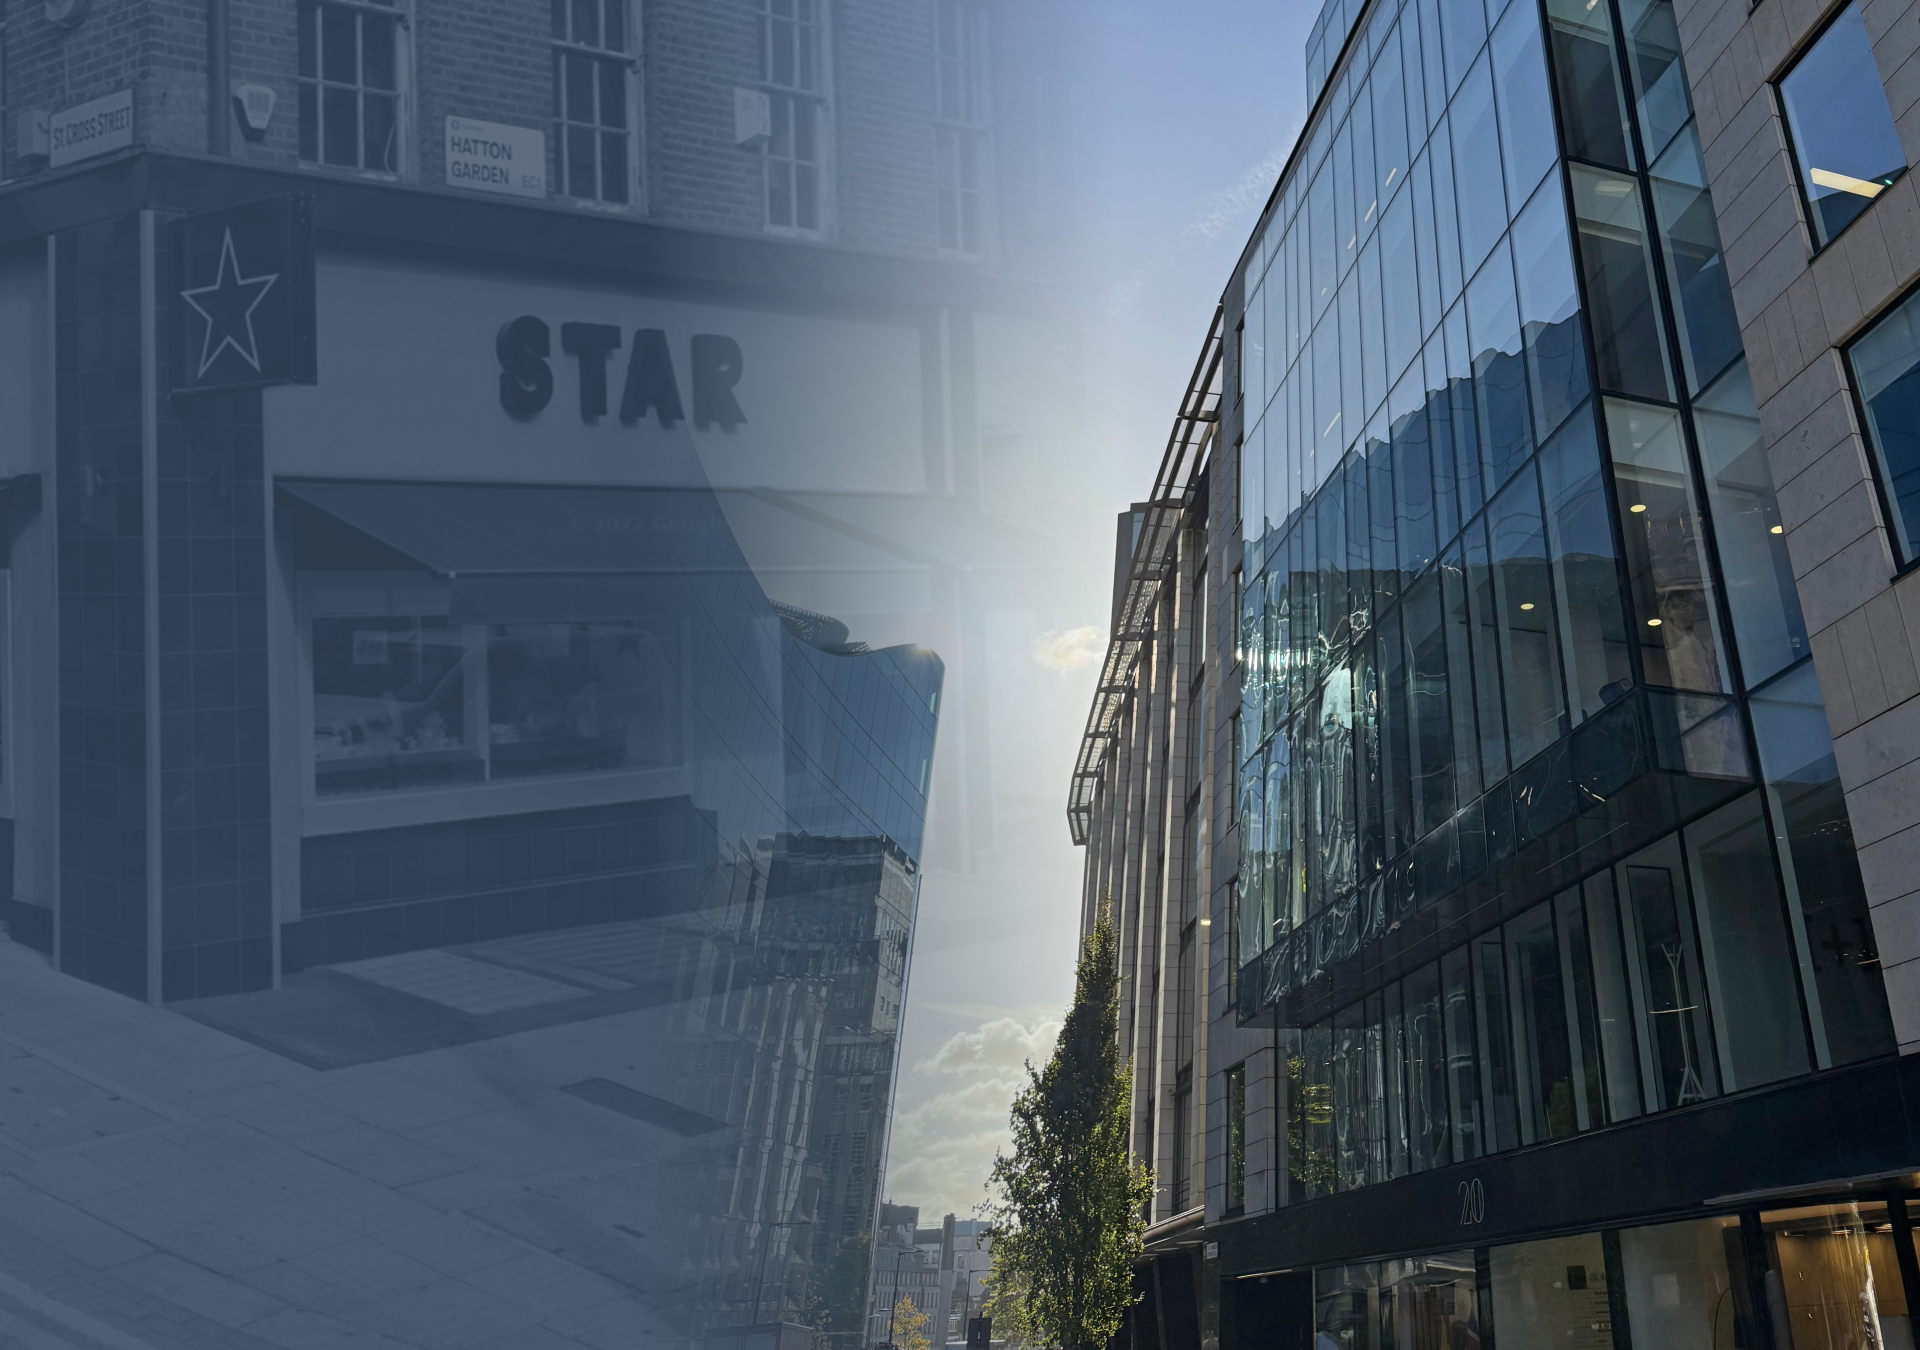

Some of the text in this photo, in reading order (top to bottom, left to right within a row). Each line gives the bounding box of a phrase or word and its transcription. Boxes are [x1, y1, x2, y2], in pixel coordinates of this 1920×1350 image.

[66, 117, 96, 145] CROSS
[98, 107, 130, 136] STREET
[451, 136, 512, 161] HATTON
[451, 160, 541, 189] GARDEN EC1
[496, 315, 748, 427] STAR
[1457, 1177, 1485, 1226] 20
